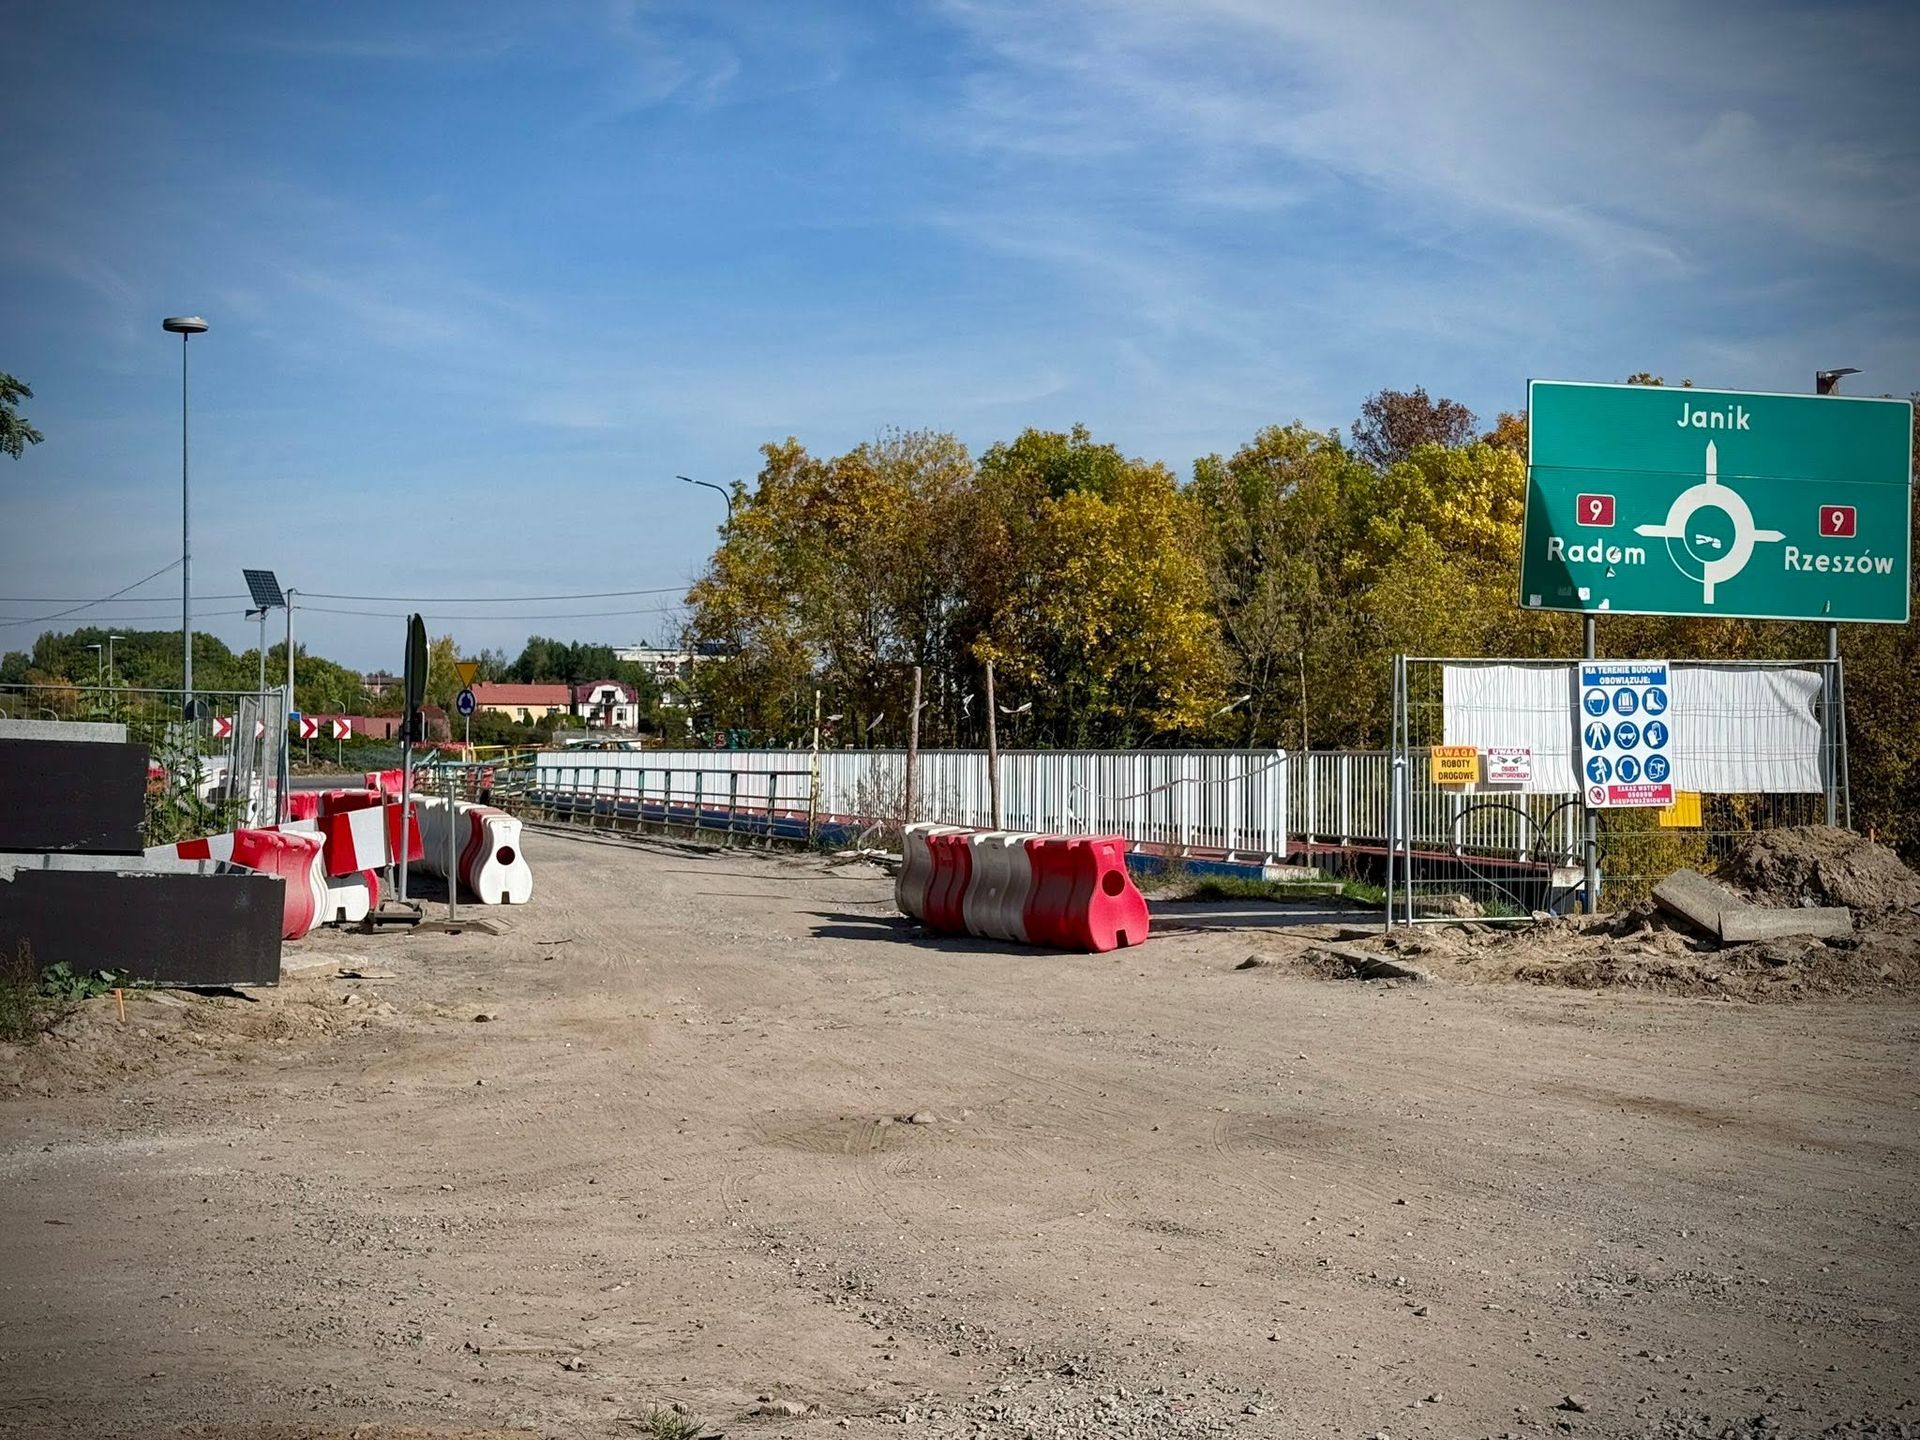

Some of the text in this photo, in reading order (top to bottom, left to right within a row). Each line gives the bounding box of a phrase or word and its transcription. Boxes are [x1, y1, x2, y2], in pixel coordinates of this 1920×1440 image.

[1677, 402, 1751, 431] Janik
[1589, 499, 1603, 521] 9
[1832, 511, 1845, 532] 9
[1547, 536, 1646, 566] Radom
[1784, 546, 1894, 575] Rzeszów
[1585, 666, 1663, 675] NA TERENIE BUDOWY
[1599, 676, 1651, 686] OBOWIĄZUJE:
[1435, 748, 1475, 757] UWAGA
[1441, 759, 1471, 768] ROBOTY
[1438, 771, 1475, 780] DROGOWE
